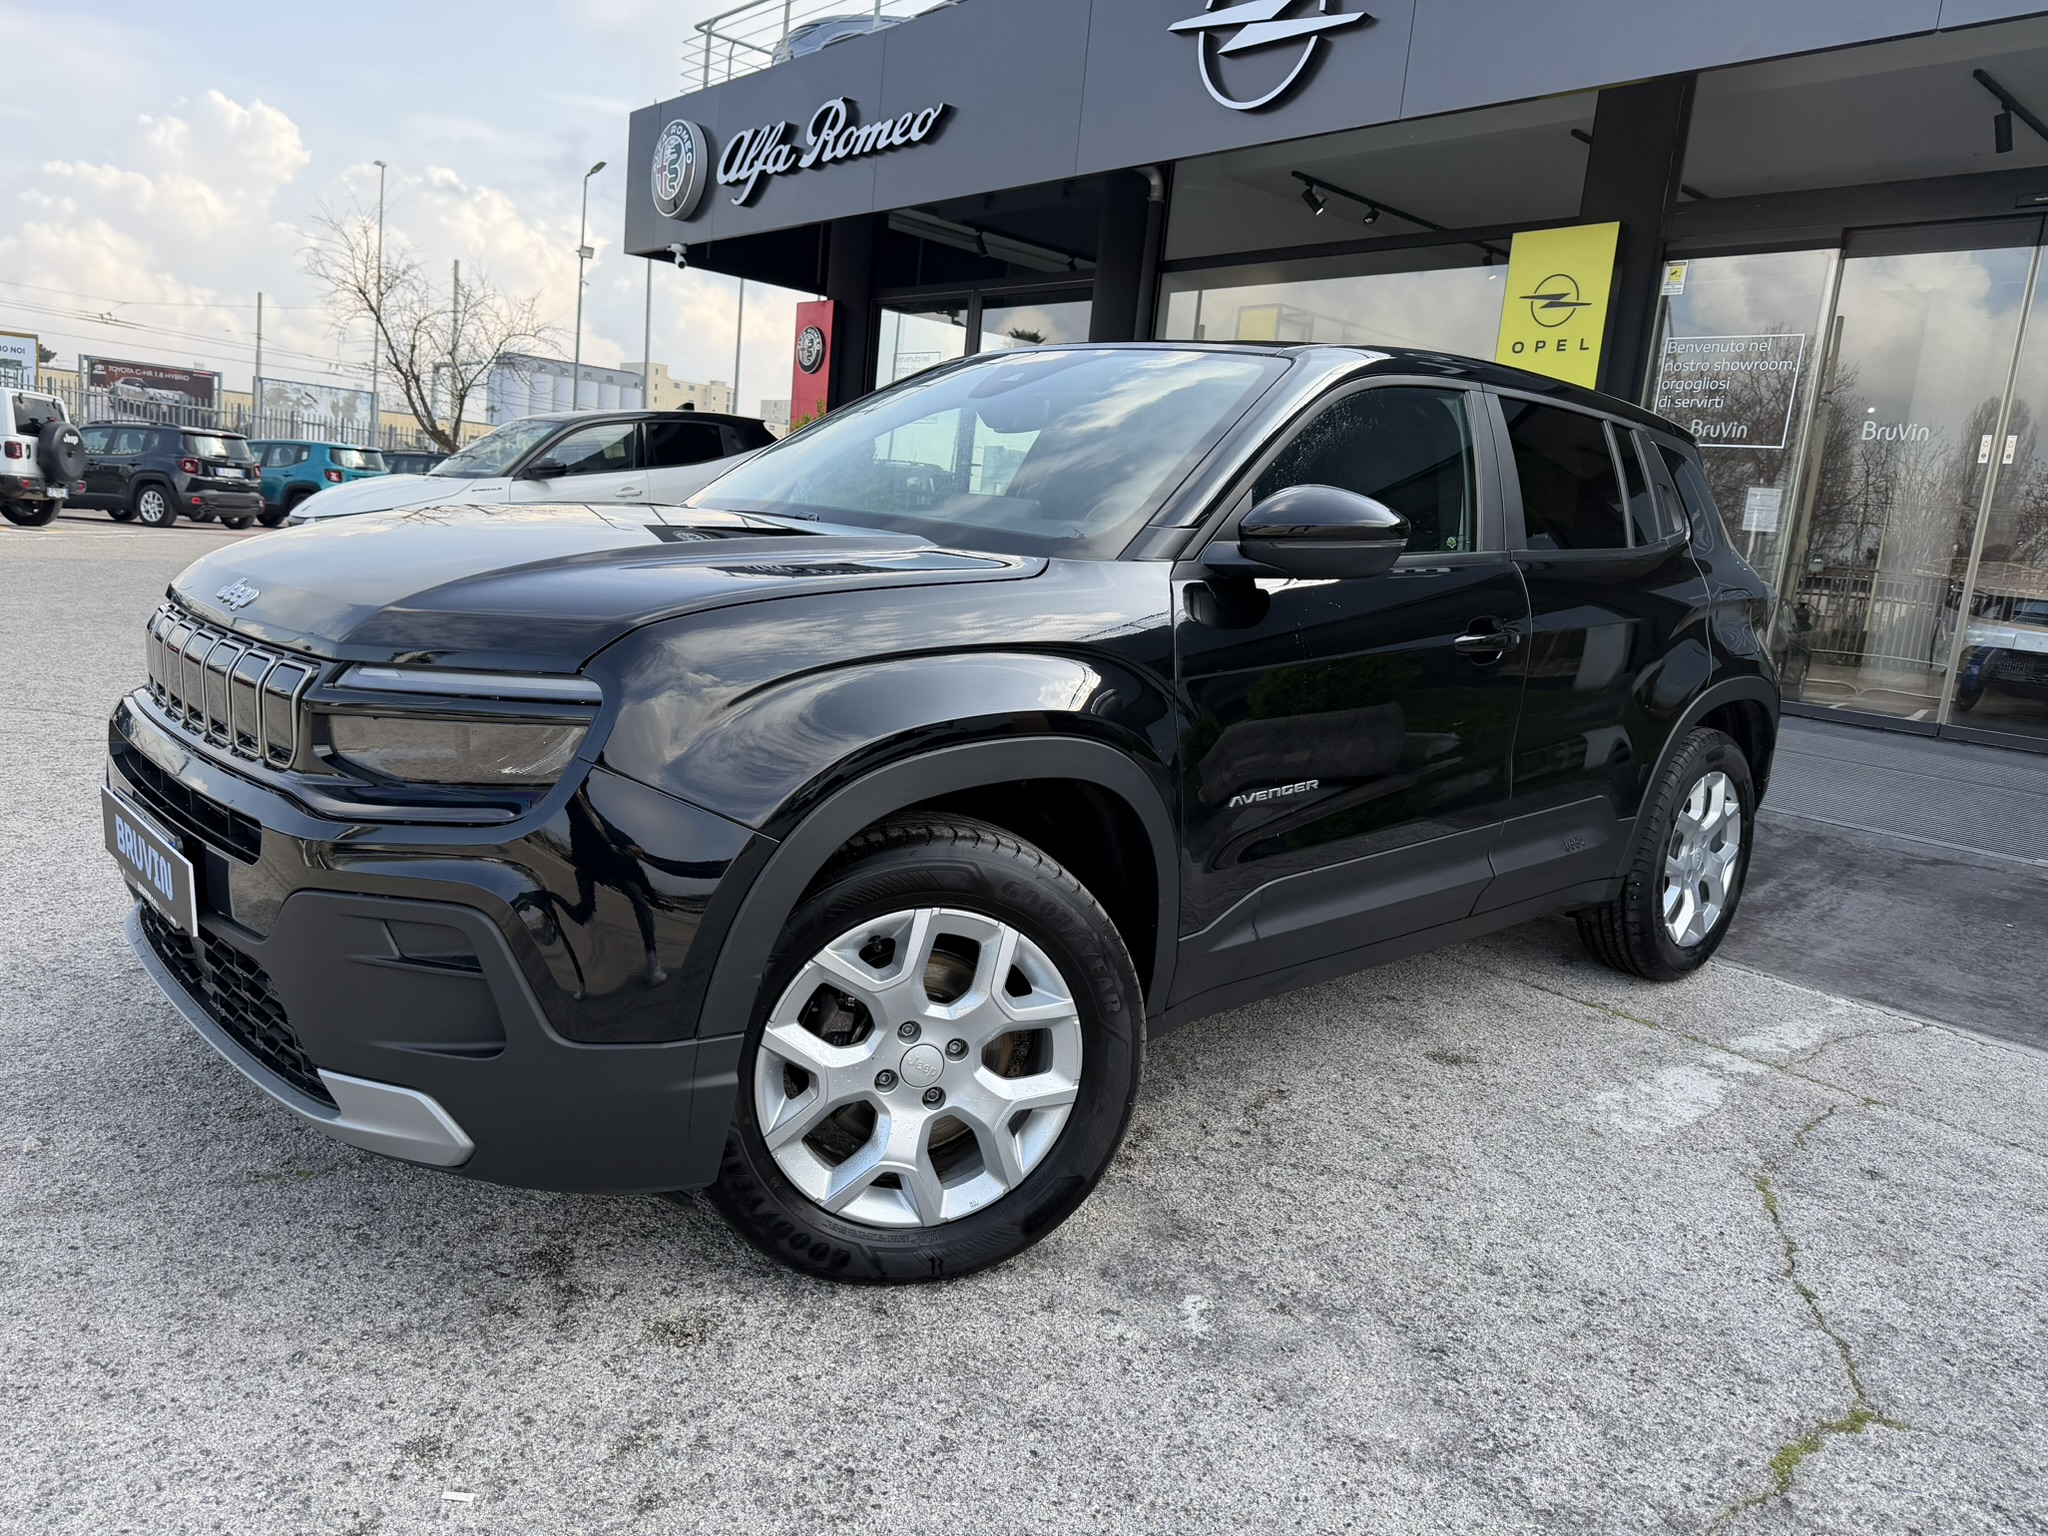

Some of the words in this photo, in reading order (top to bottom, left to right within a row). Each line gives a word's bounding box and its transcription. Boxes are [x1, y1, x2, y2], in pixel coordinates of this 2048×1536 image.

[671, 125, 693, 164] ROMEO
[716, 121, 796, 206] Alfa
[798, 97, 944, 169] Romeo
[10, 346, 26, 355] NOI
[1512, 338, 1590, 354] OPEL
[1668, 340, 1745, 354] Benvenuto
[1749, 337, 1773, 352] nel
[107, 365, 135, 375] TOYOTA
[135, 369, 154, 378] C-HR
[154, 371, 164, 379] 1.8
[164, 373, 190, 382] HYBRID
[1664, 358, 1710, 372] nostro
[1713, 358, 1797, 373] showroom,
[1661, 377, 1731, 393] orgogliosi
[1658, 396, 1672, 408] di
[1674, 396, 1725, 408] servirti
[1690, 419, 1748, 439] BruVin
[1861, 420, 1930, 442] BruVin
[63, 433, 79, 446] Jeep
[216, 577, 260, 611] Jeep
[1229, 780, 1319, 808] AVENGER
[115, 813, 174, 901] BRUVIN
[1001, 880, 1122, 1013] GOODYEAR
[906, 1055, 938, 1078] Jeep
